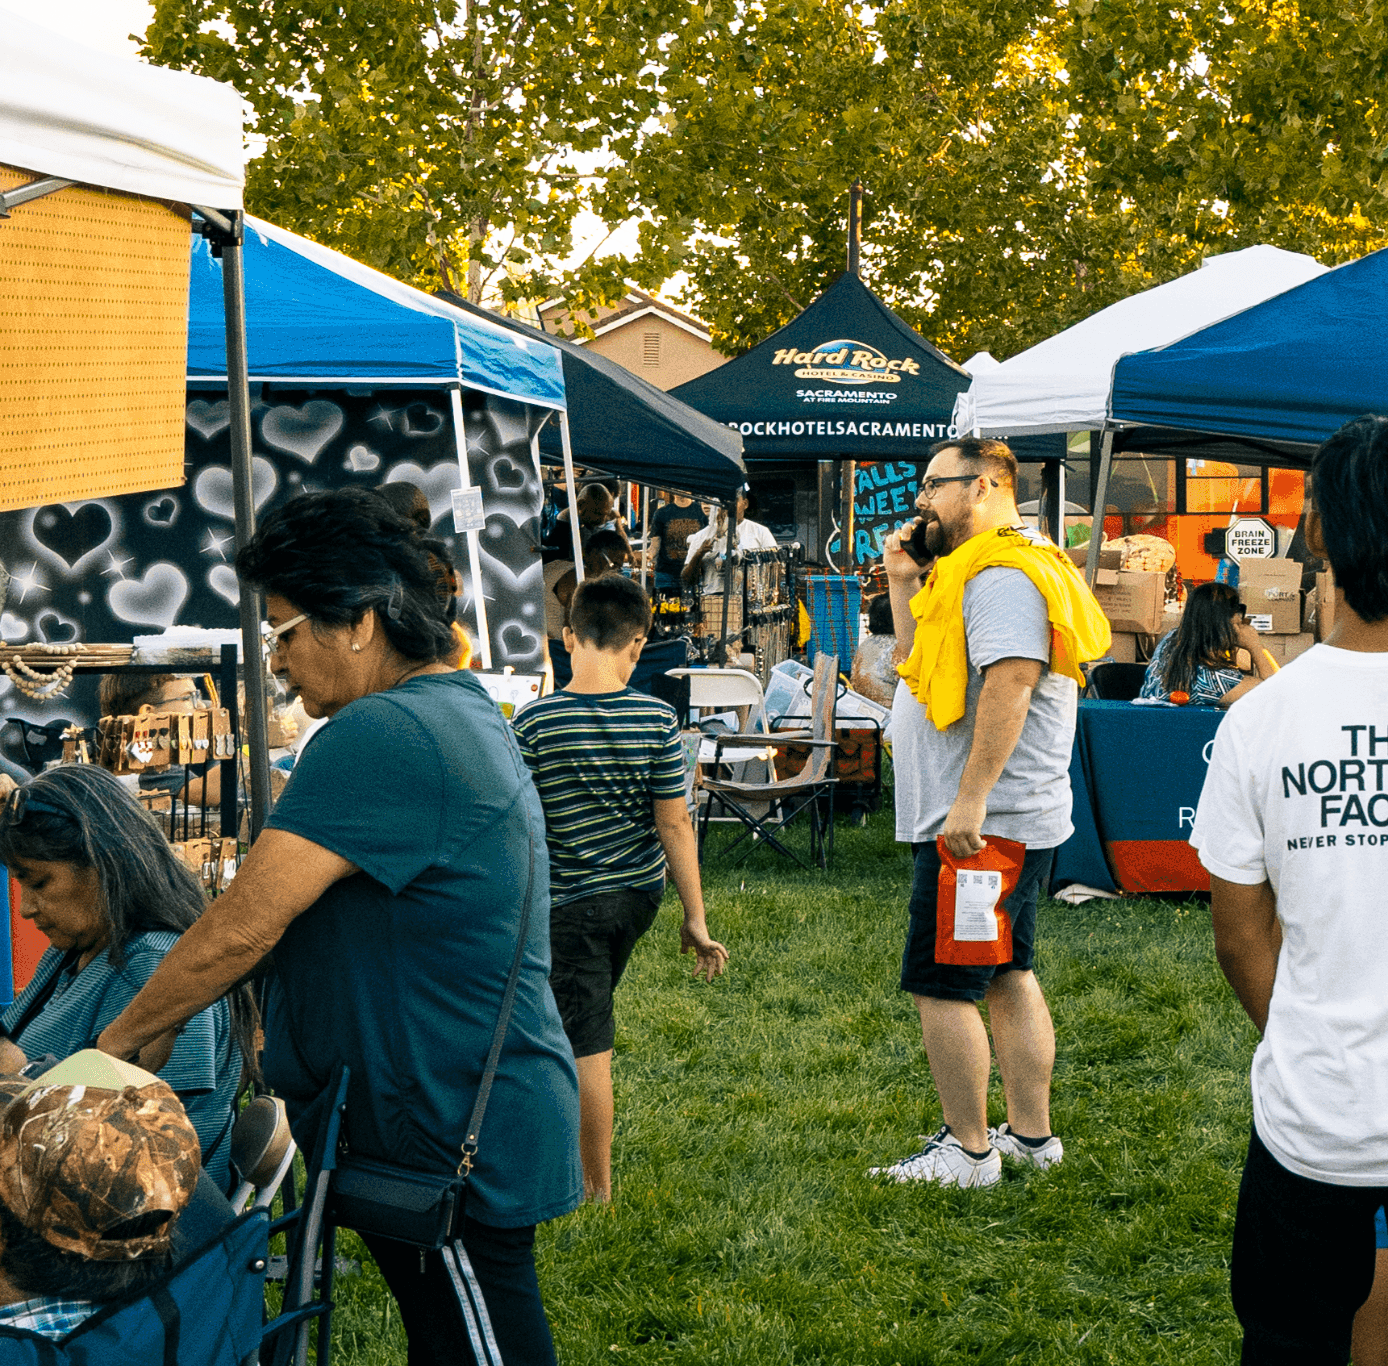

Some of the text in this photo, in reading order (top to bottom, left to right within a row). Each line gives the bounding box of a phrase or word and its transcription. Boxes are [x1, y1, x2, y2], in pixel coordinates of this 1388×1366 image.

[772, 348, 920, 376] Hard Rock
[852, 373, 895, 381] CASINO
[796, 389, 898, 400] SACRAMENTO
[853, 460, 917, 496] ALLS
[1237, 547, 1265, 555] ZONE
[1287, 835, 1337, 851] NEVER
